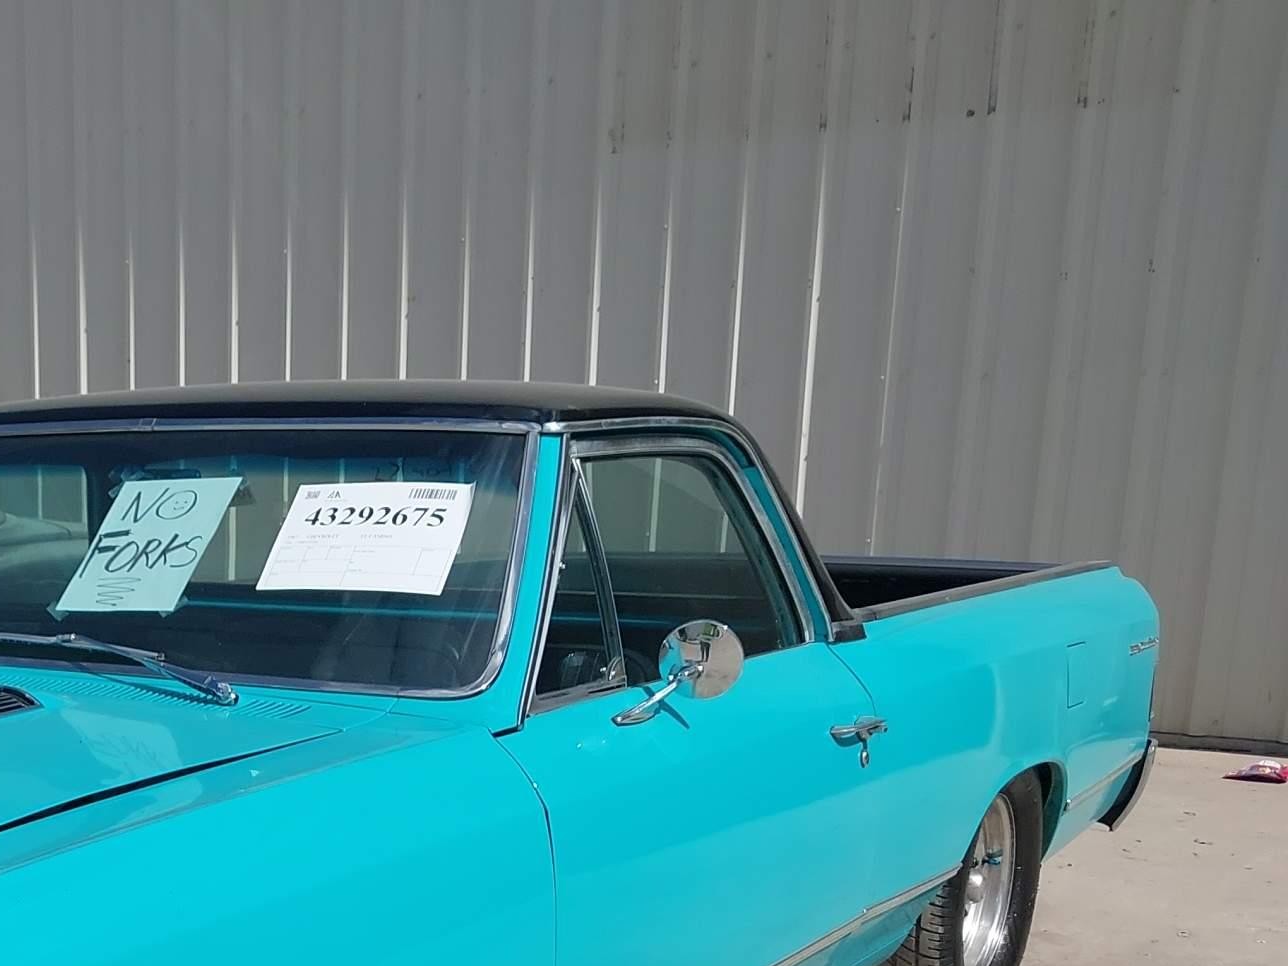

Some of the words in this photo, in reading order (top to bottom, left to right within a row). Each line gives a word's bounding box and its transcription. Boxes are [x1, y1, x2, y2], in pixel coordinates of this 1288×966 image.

[121, 488, 198, 523] NO
[304, 505, 448, 528] 43292675
[78, 529, 203, 579] FORKS
